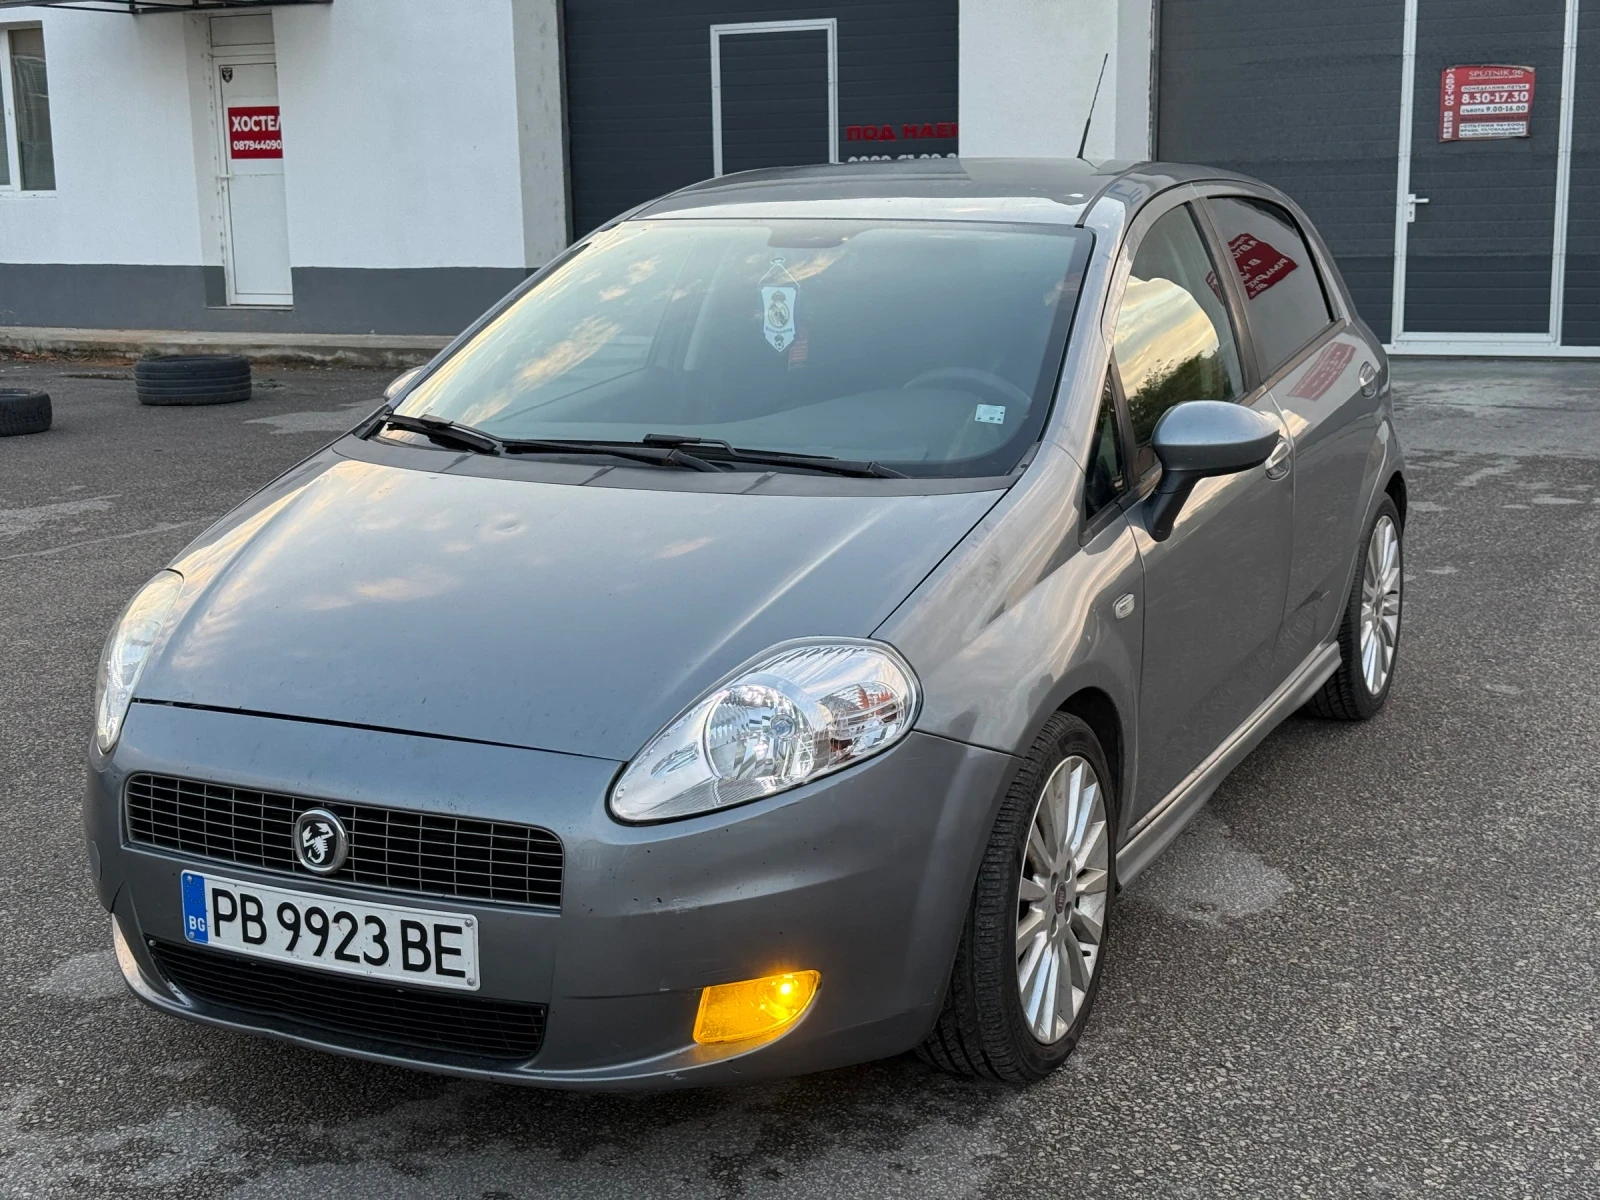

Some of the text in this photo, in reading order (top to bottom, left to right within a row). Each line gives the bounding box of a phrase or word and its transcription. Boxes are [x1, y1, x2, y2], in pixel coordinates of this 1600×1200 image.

[1462, 92, 1529, 104] 8.30-17.30
[1485, 105, 1526, 113] 9.00-16.00
[846, 125, 896, 142] ПОД
[188, 914, 206, 932] BG
[211, 887, 466, 978] PB 9923 BE
